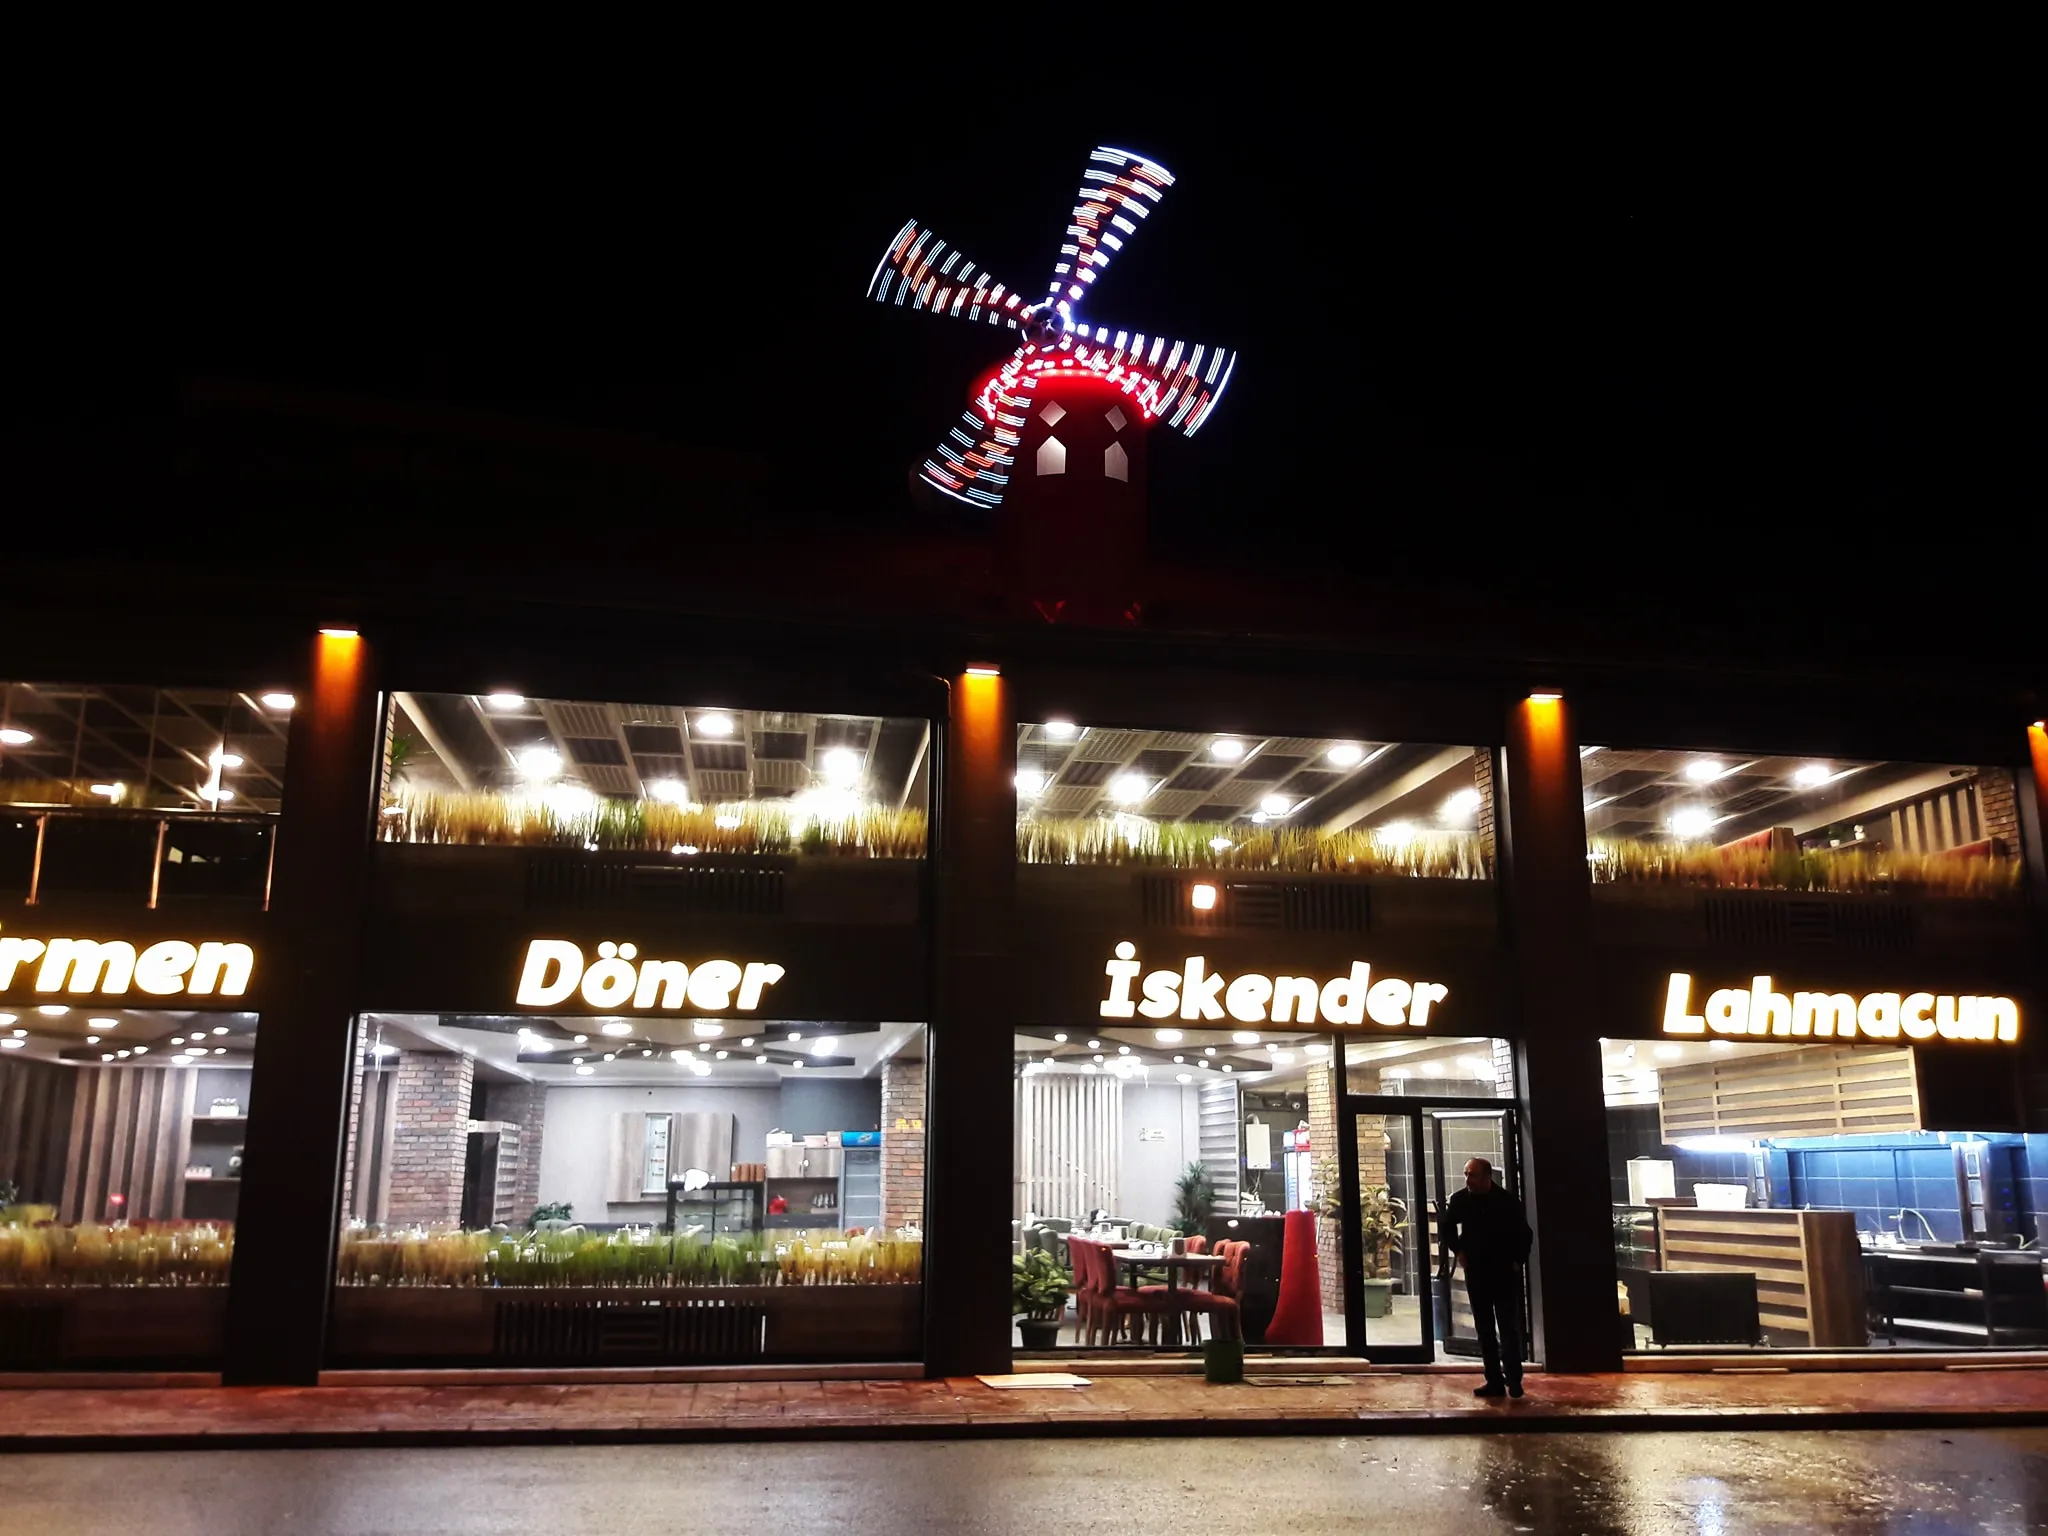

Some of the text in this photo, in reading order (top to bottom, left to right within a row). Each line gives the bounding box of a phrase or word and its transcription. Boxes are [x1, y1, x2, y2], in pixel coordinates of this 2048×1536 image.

[0, 922, 254, 996] rmen
[516, 939, 785, 1010] Döner
[1662, 972, 2019, 1041] Lahmacun
